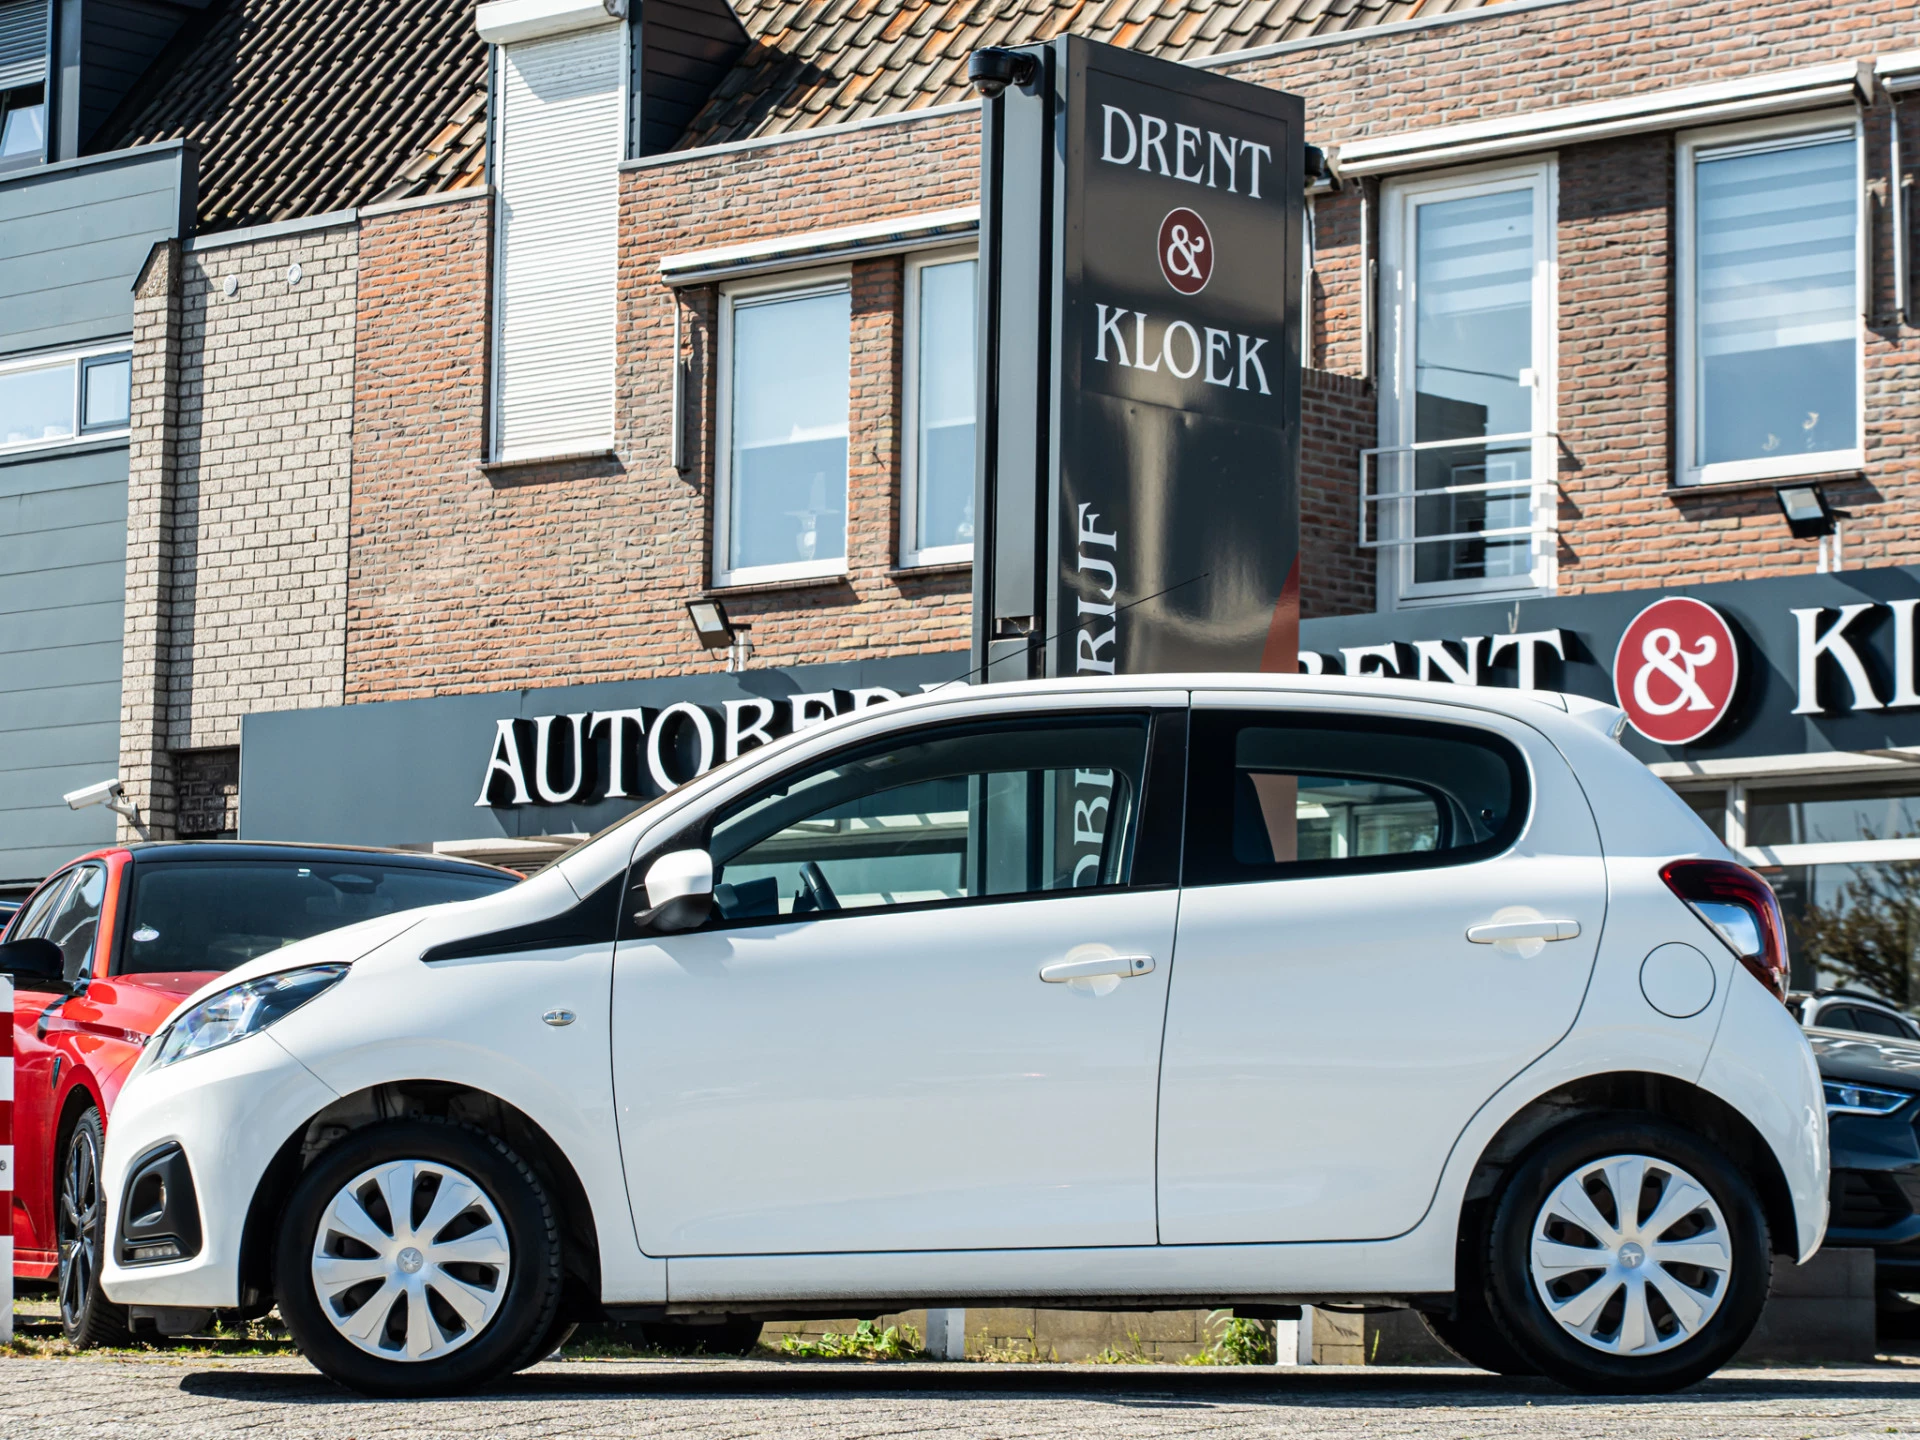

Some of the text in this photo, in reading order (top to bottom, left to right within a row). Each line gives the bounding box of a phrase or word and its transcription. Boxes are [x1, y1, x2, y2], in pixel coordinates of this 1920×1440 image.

[1101, 104, 1272, 199] DRENT
[1166, 224, 1205, 280] &
[1095, 303, 1272, 395] KLOEK
[1633, 627, 1718, 715] &
